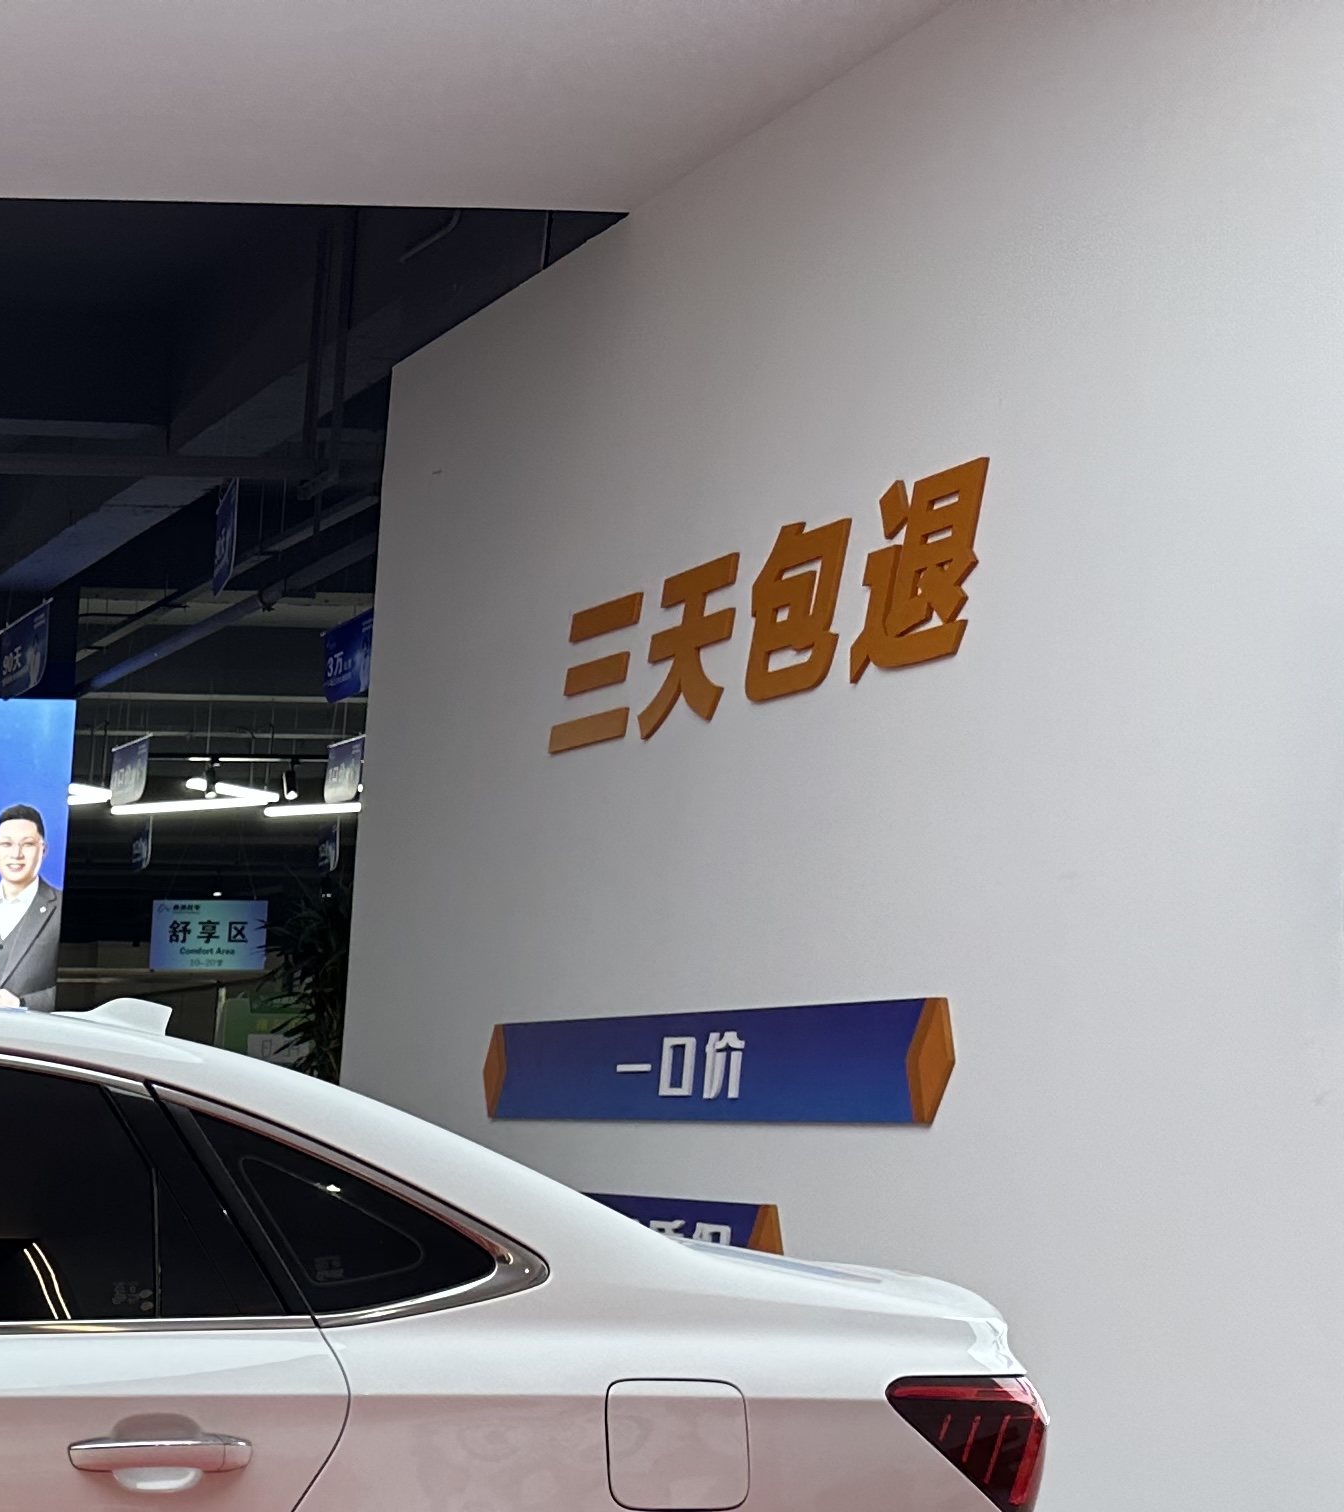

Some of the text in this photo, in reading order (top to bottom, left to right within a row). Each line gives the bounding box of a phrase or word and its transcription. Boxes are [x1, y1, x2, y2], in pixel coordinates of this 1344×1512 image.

[548, 456, 990, 754] 三天包退
[168, 919, 249, 943] 舒享区
[180, 947, 235, 955] Comfort Area
[616, 1031, 746, 1099] 一口价
